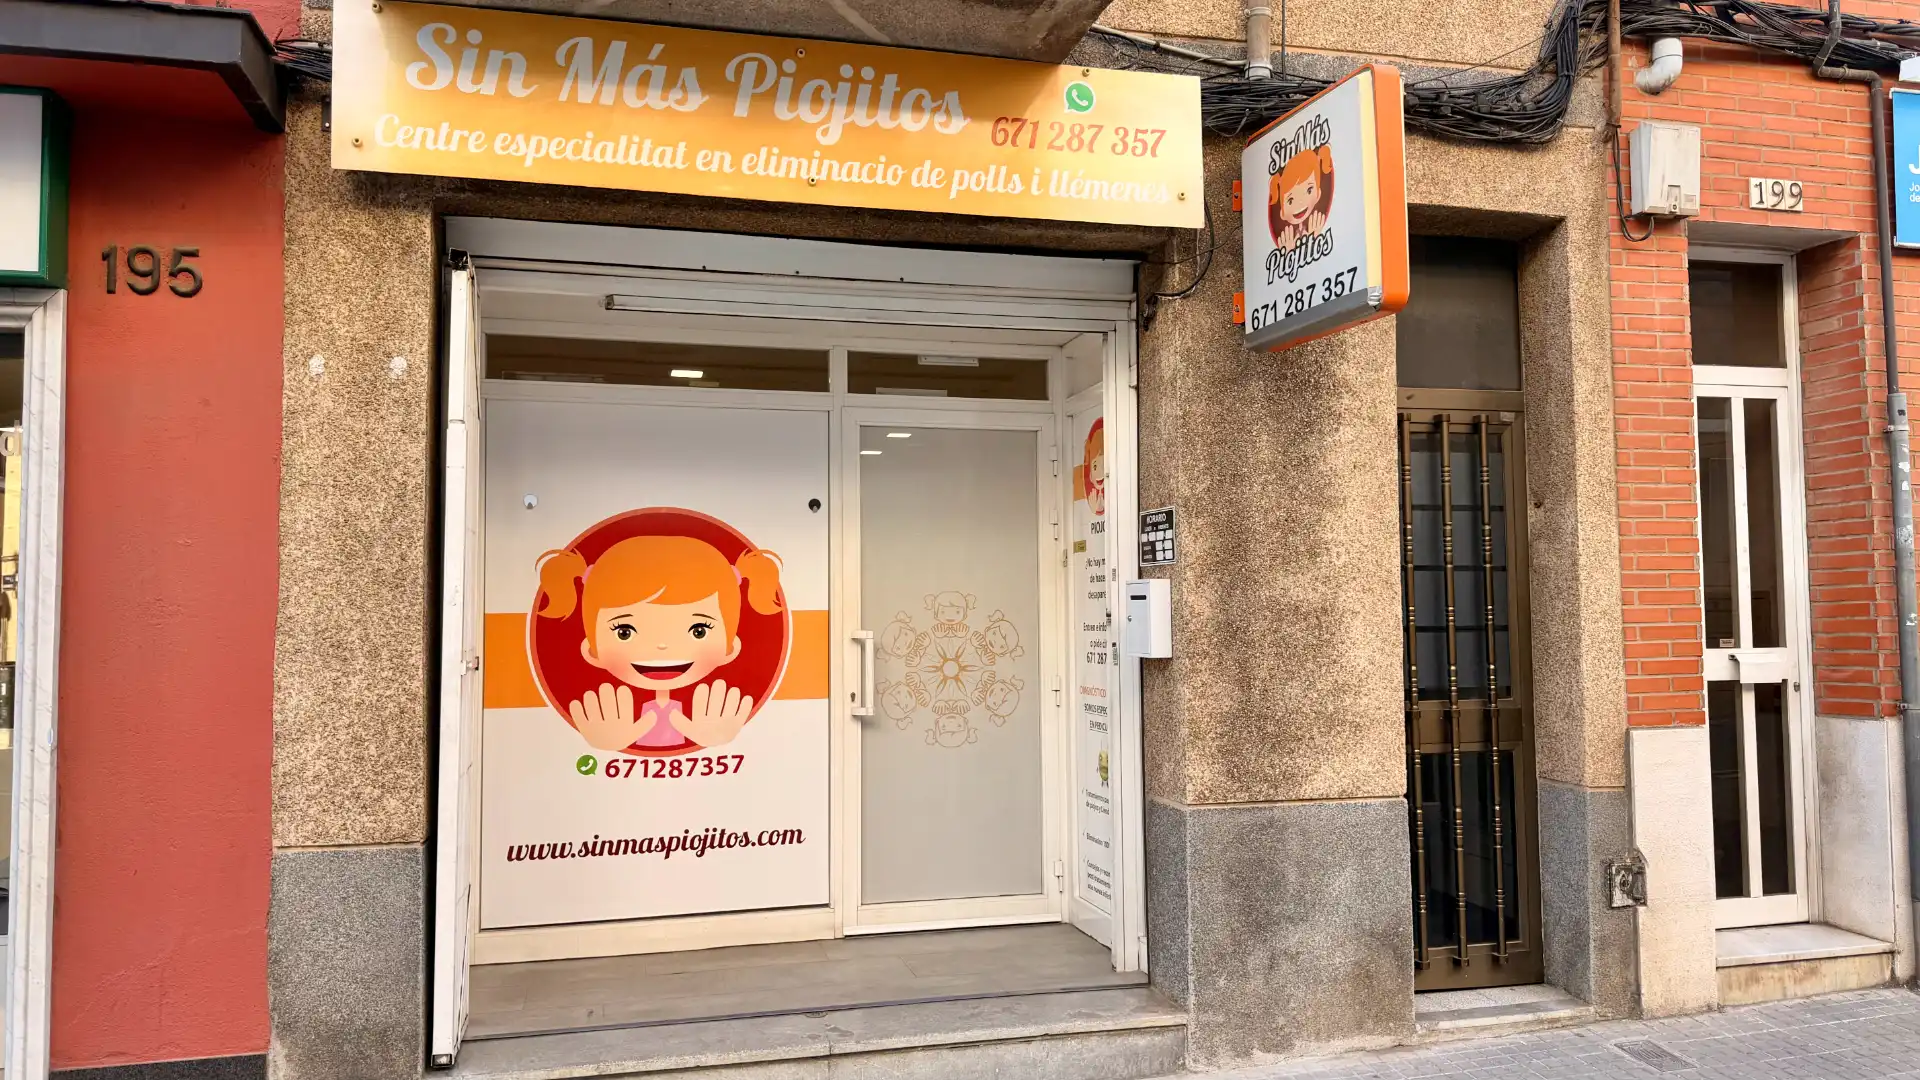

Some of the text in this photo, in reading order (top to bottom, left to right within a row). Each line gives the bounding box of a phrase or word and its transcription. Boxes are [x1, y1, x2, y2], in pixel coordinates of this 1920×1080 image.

[405, 23, 970, 146] Sin Más Piojitos
[374, 114, 1169, 205] Centre especialitat en eliminacio de polls i llémenes
[990, 117, 1167, 158] 671 287 357
[1753, 180, 1803, 209] 199
[102, 244, 203, 298] 195
[1265, 227, 1333, 285] Piojitos
[1251, 266, 1358, 331] 671 287 357
[1087, 651, 1096, 664] 671
[1097, 652, 1107, 665] 287
[605, 755, 745, 778] 671287357
[506, 827, 806, 862] www.sinmaspiojitos.com
